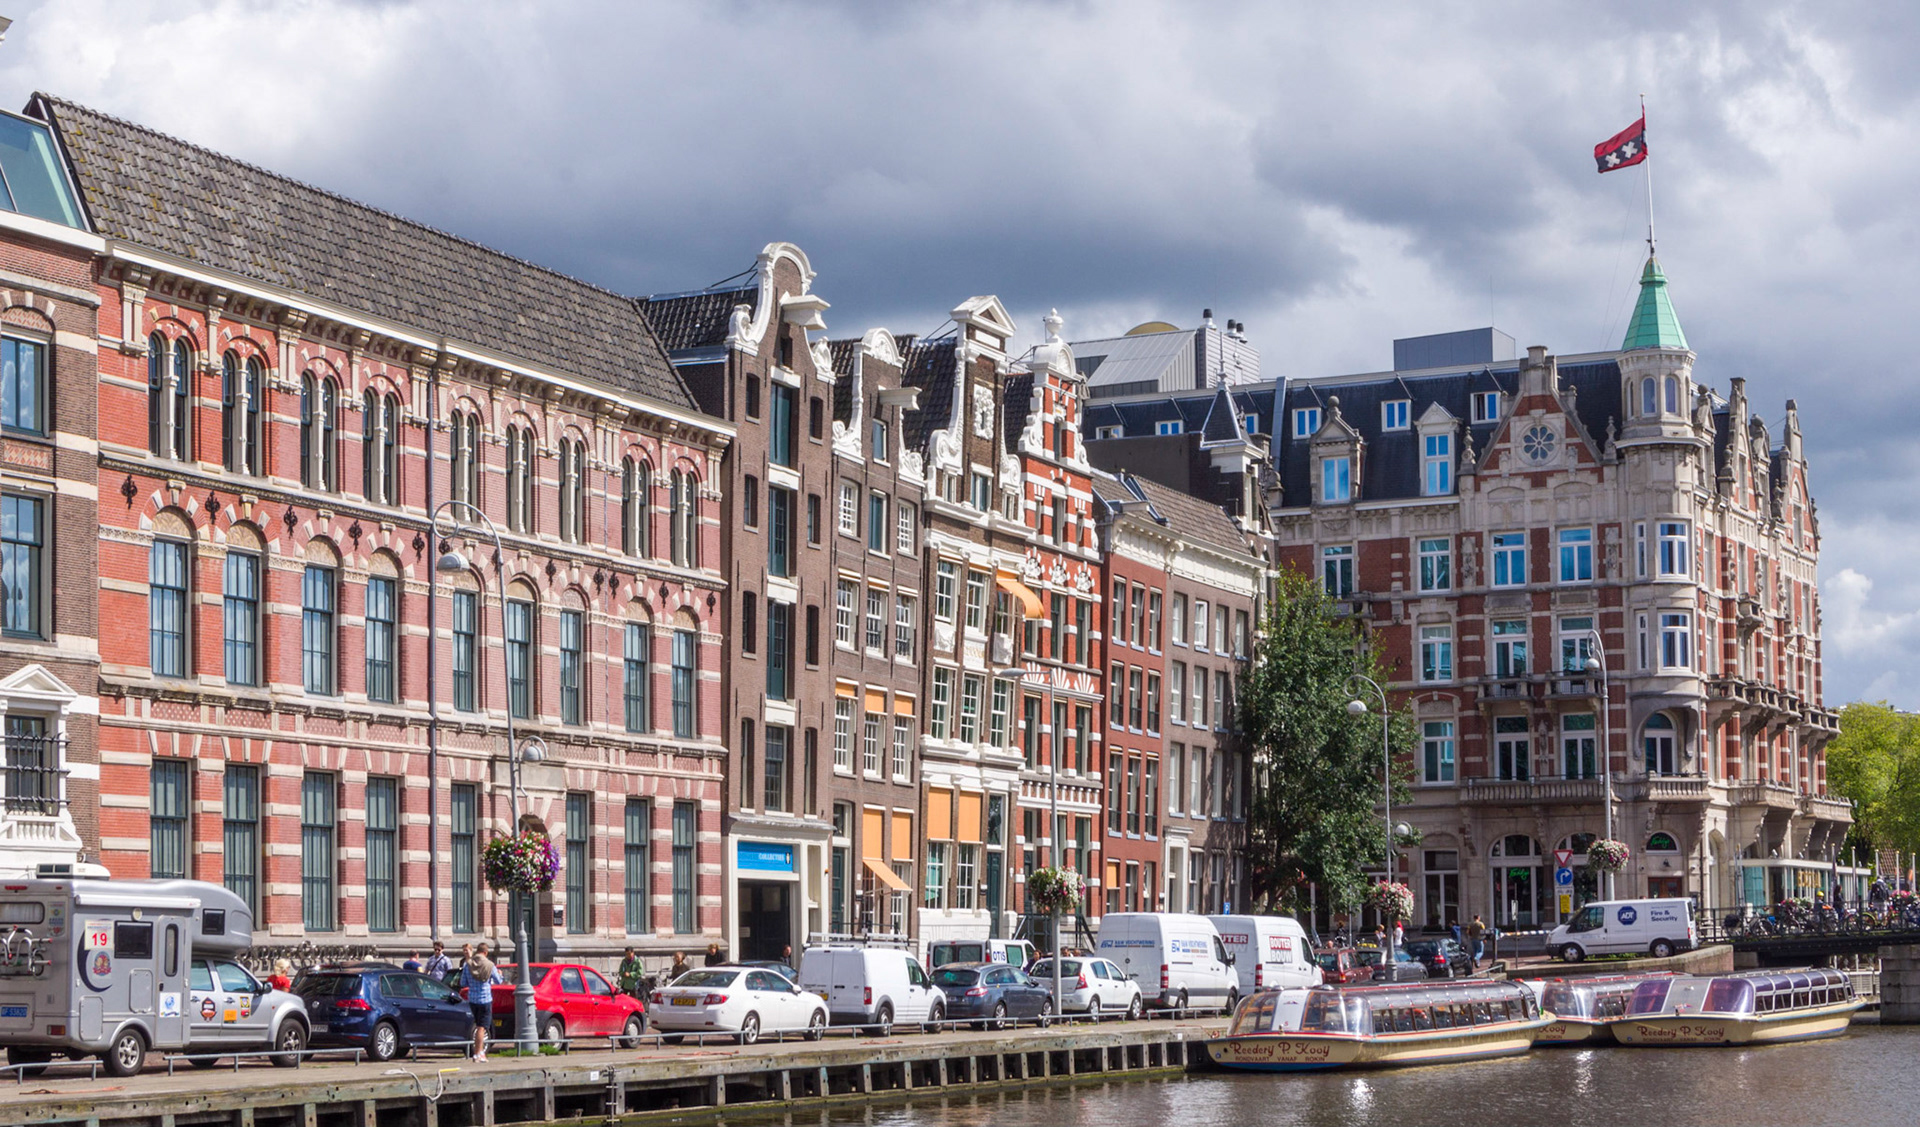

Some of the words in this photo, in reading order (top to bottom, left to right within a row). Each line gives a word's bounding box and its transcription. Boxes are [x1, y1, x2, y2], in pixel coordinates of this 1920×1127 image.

[1620, 911, 1634, 920] ADT
[91, 932, 108, 946] 19
[1220, 935, 1248, 944] UTER
[1270, 937, 1292, 949] BOUTER
[992, 950, 1006, 962] OTIS
[1271, 949, 1293, 964] BOUW
